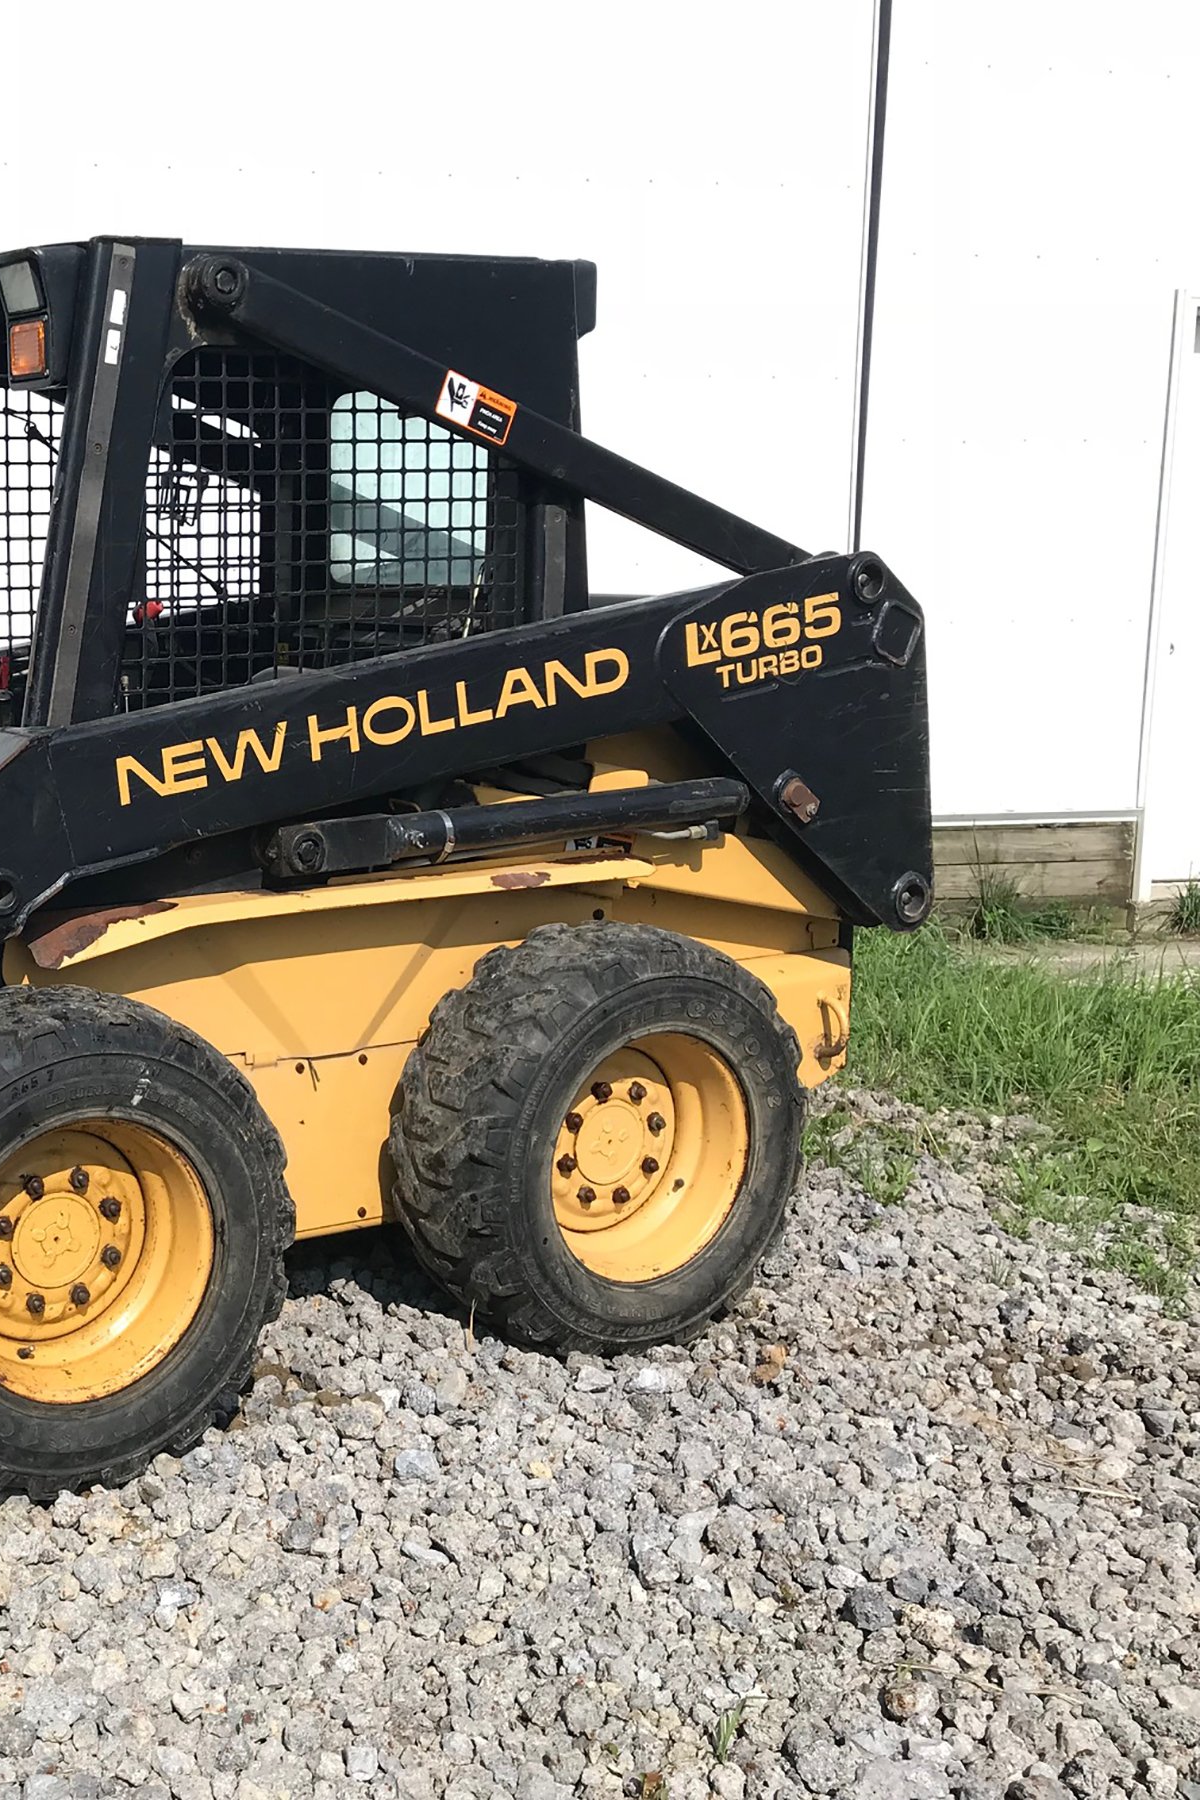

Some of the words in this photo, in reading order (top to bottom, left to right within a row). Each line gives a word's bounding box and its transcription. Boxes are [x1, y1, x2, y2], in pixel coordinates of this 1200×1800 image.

[717, 645, 822, 688] TURBO
[116, 721, 287, 806] NEW
[308, 648, 630, 762] HOLLAND
